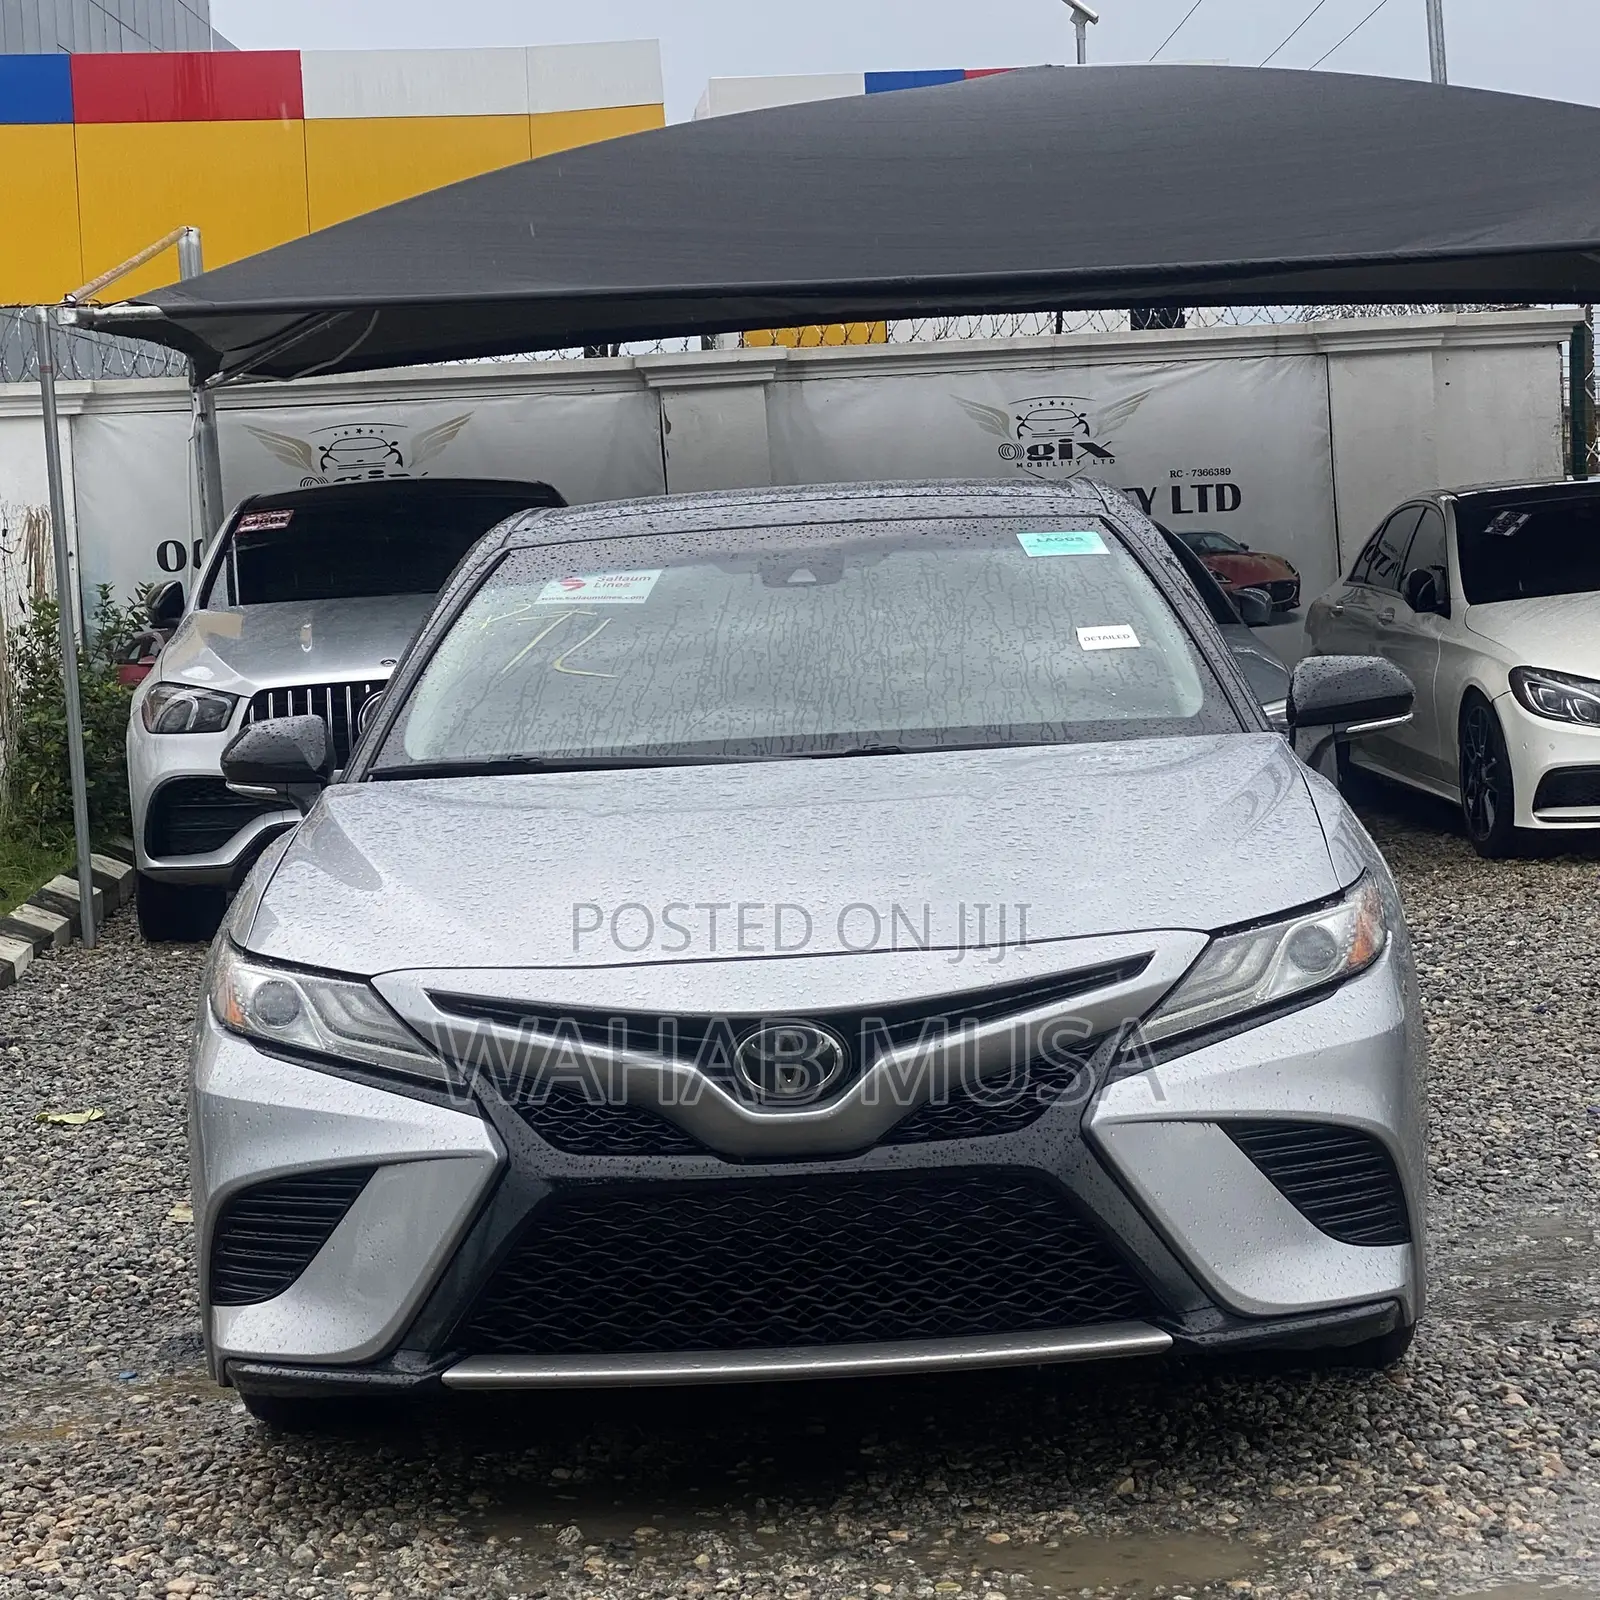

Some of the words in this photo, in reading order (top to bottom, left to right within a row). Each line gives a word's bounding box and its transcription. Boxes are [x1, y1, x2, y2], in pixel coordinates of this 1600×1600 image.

[1016, 460, 1081, 468] MOBILITY
[1092, 458, 1116, 466] LTD
[1169, 469, 1184, 478] RC
[1191, 467, 1232, 477] 7366389
[1171, 483, 1242, 514] LTD
[593, 581, 632, 589] Lines
[1083, 633, 1131, 642] DETAILED
